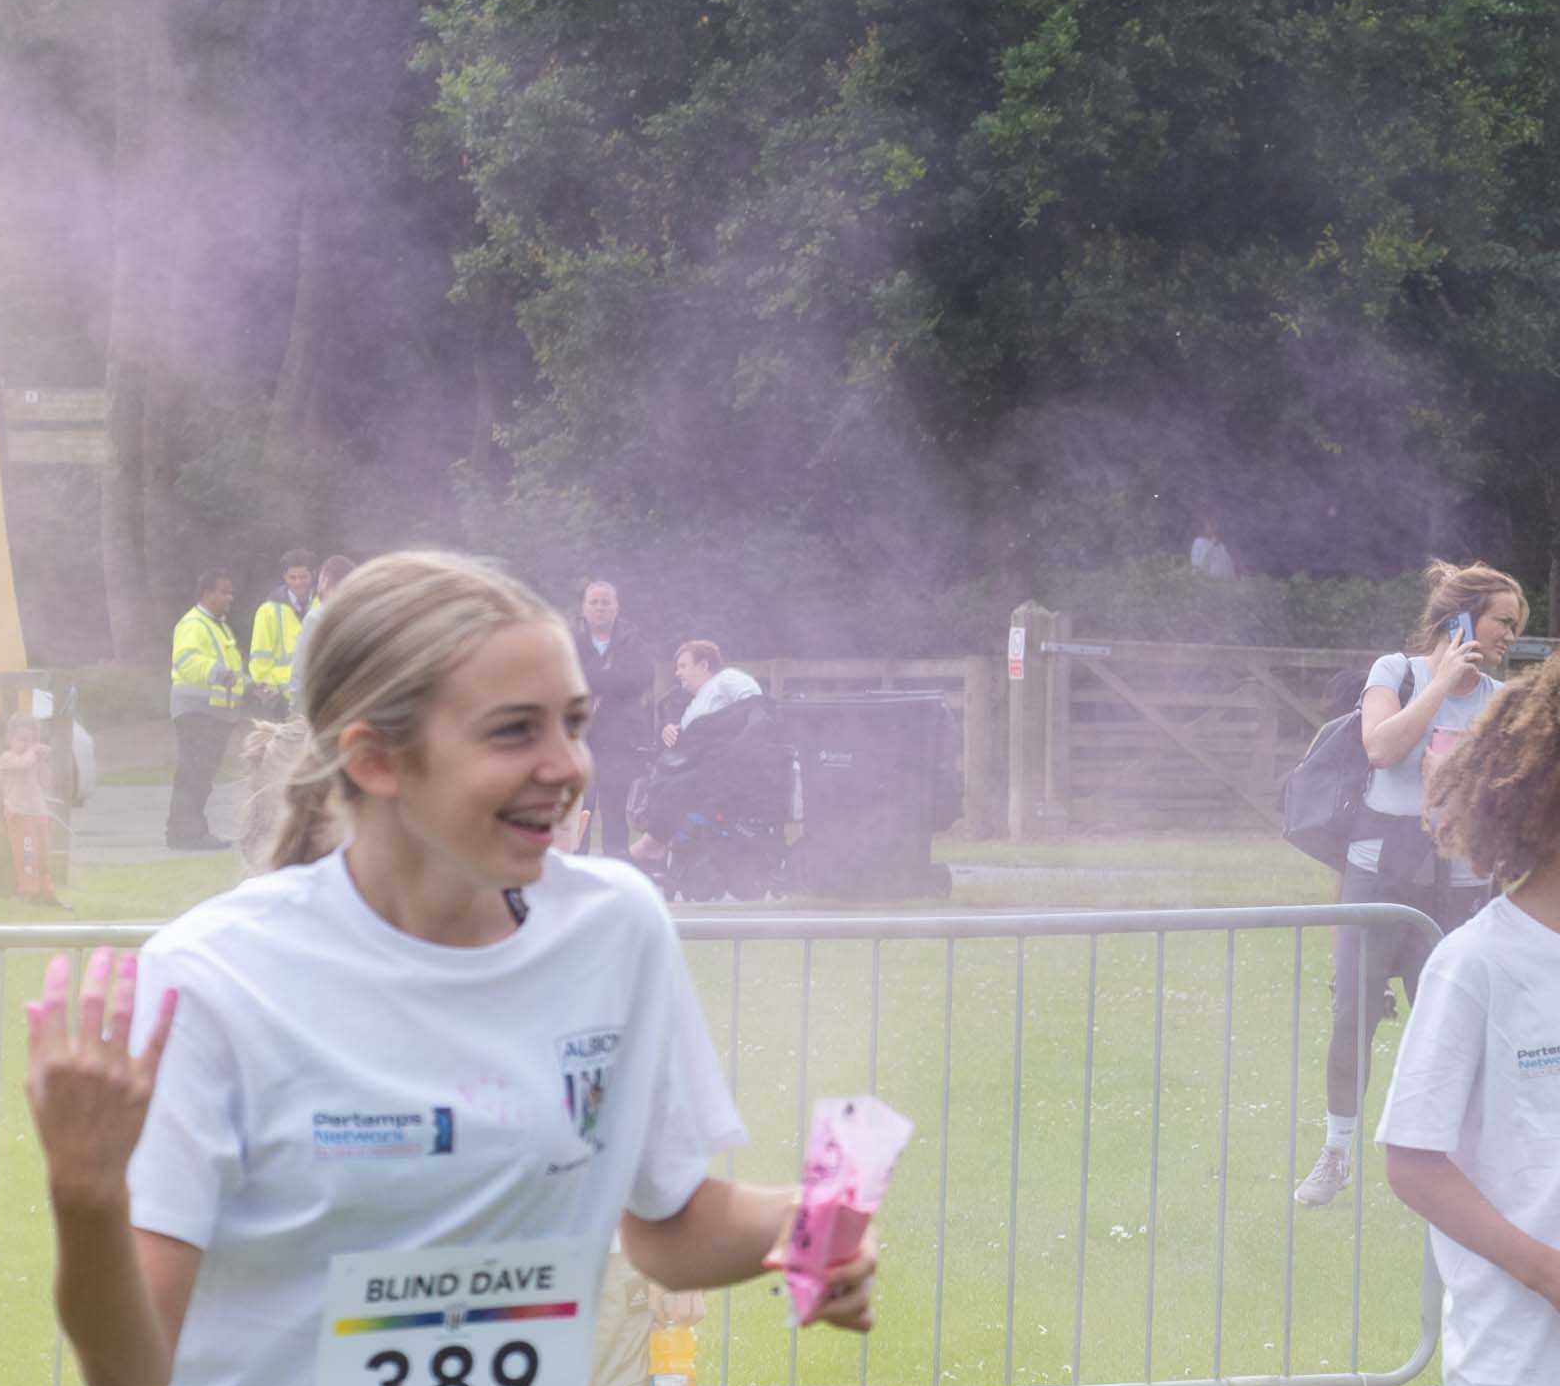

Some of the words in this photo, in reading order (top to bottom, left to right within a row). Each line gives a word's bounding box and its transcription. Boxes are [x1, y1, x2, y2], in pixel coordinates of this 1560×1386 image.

[313, 1112, 423, 1128] Pertemps
[365, 1271, 459, 1304] BLIND
[469, 1264, 555, 1296] DAVE
